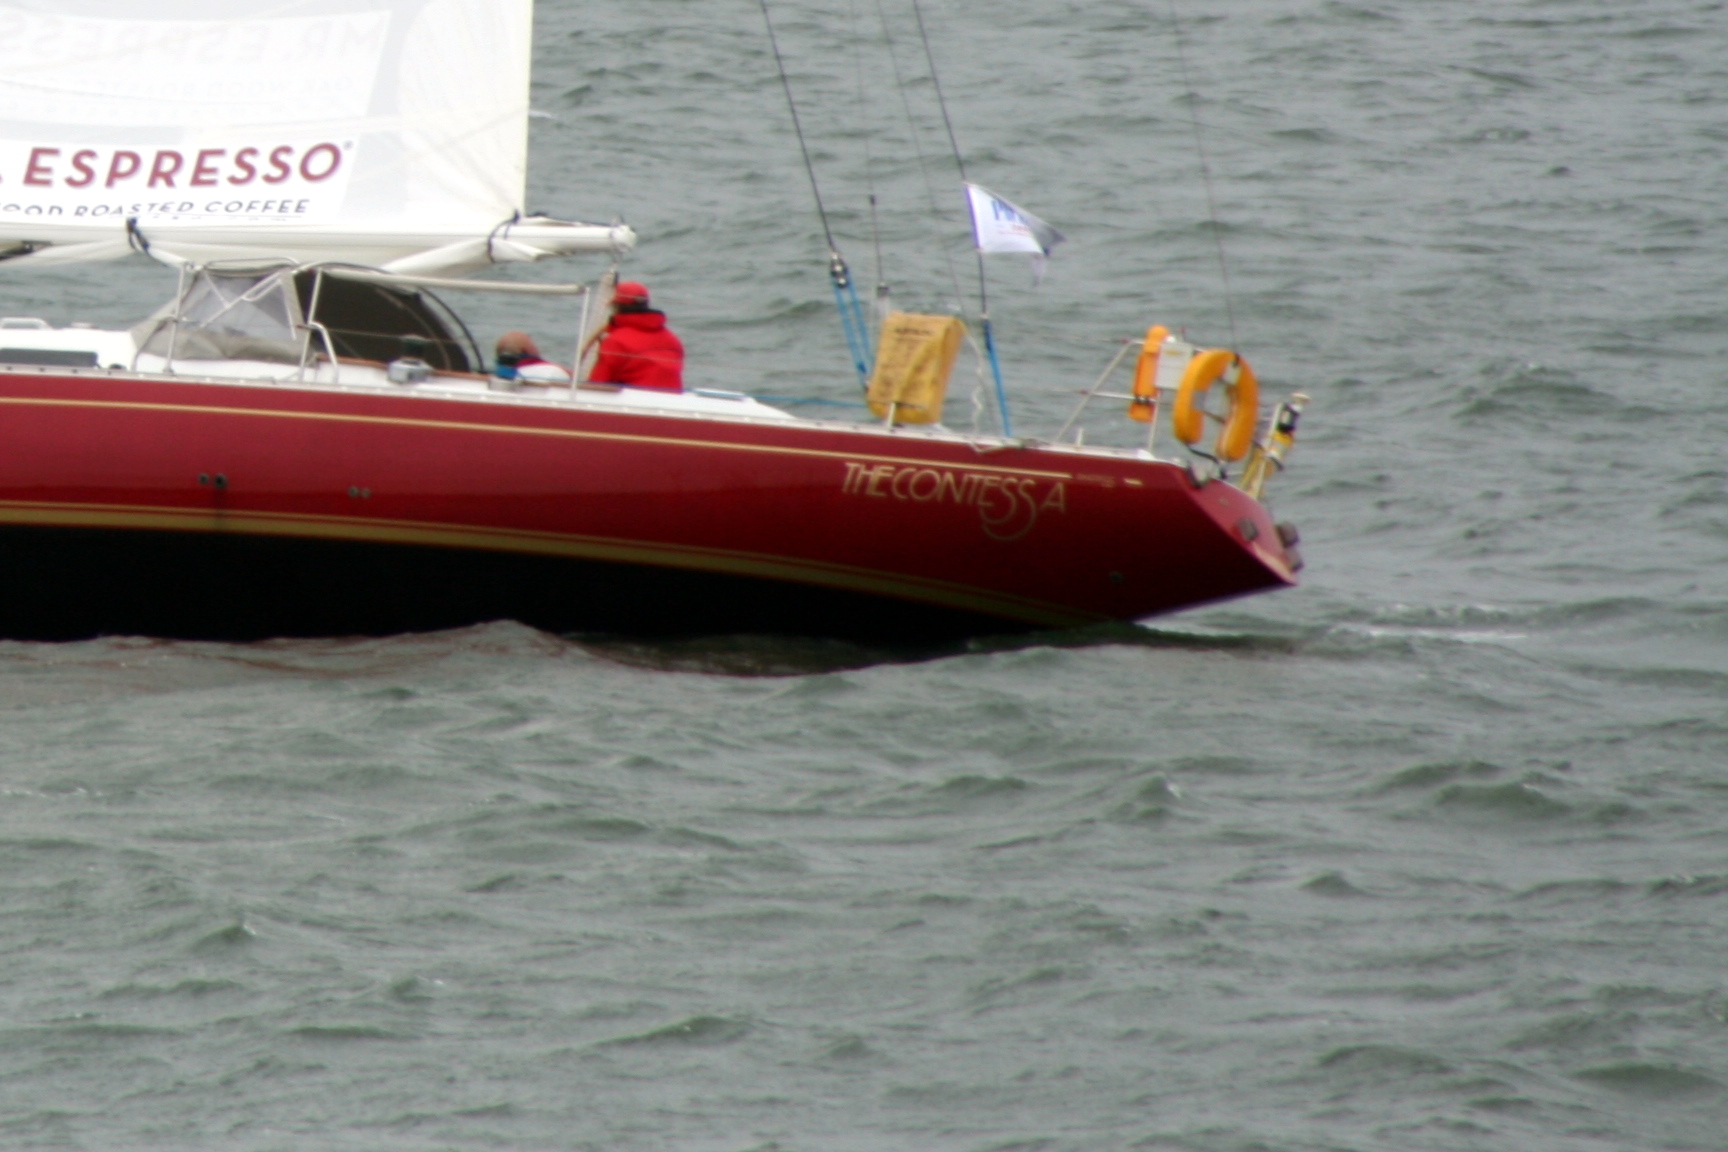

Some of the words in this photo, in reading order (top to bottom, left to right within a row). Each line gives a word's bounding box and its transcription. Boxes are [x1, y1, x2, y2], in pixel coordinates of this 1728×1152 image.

[22, 142, 342, 189] ESPRESSO
[74, 201, 195, 216] ROASTED
[205, 199, 310, 214] COFFEE
